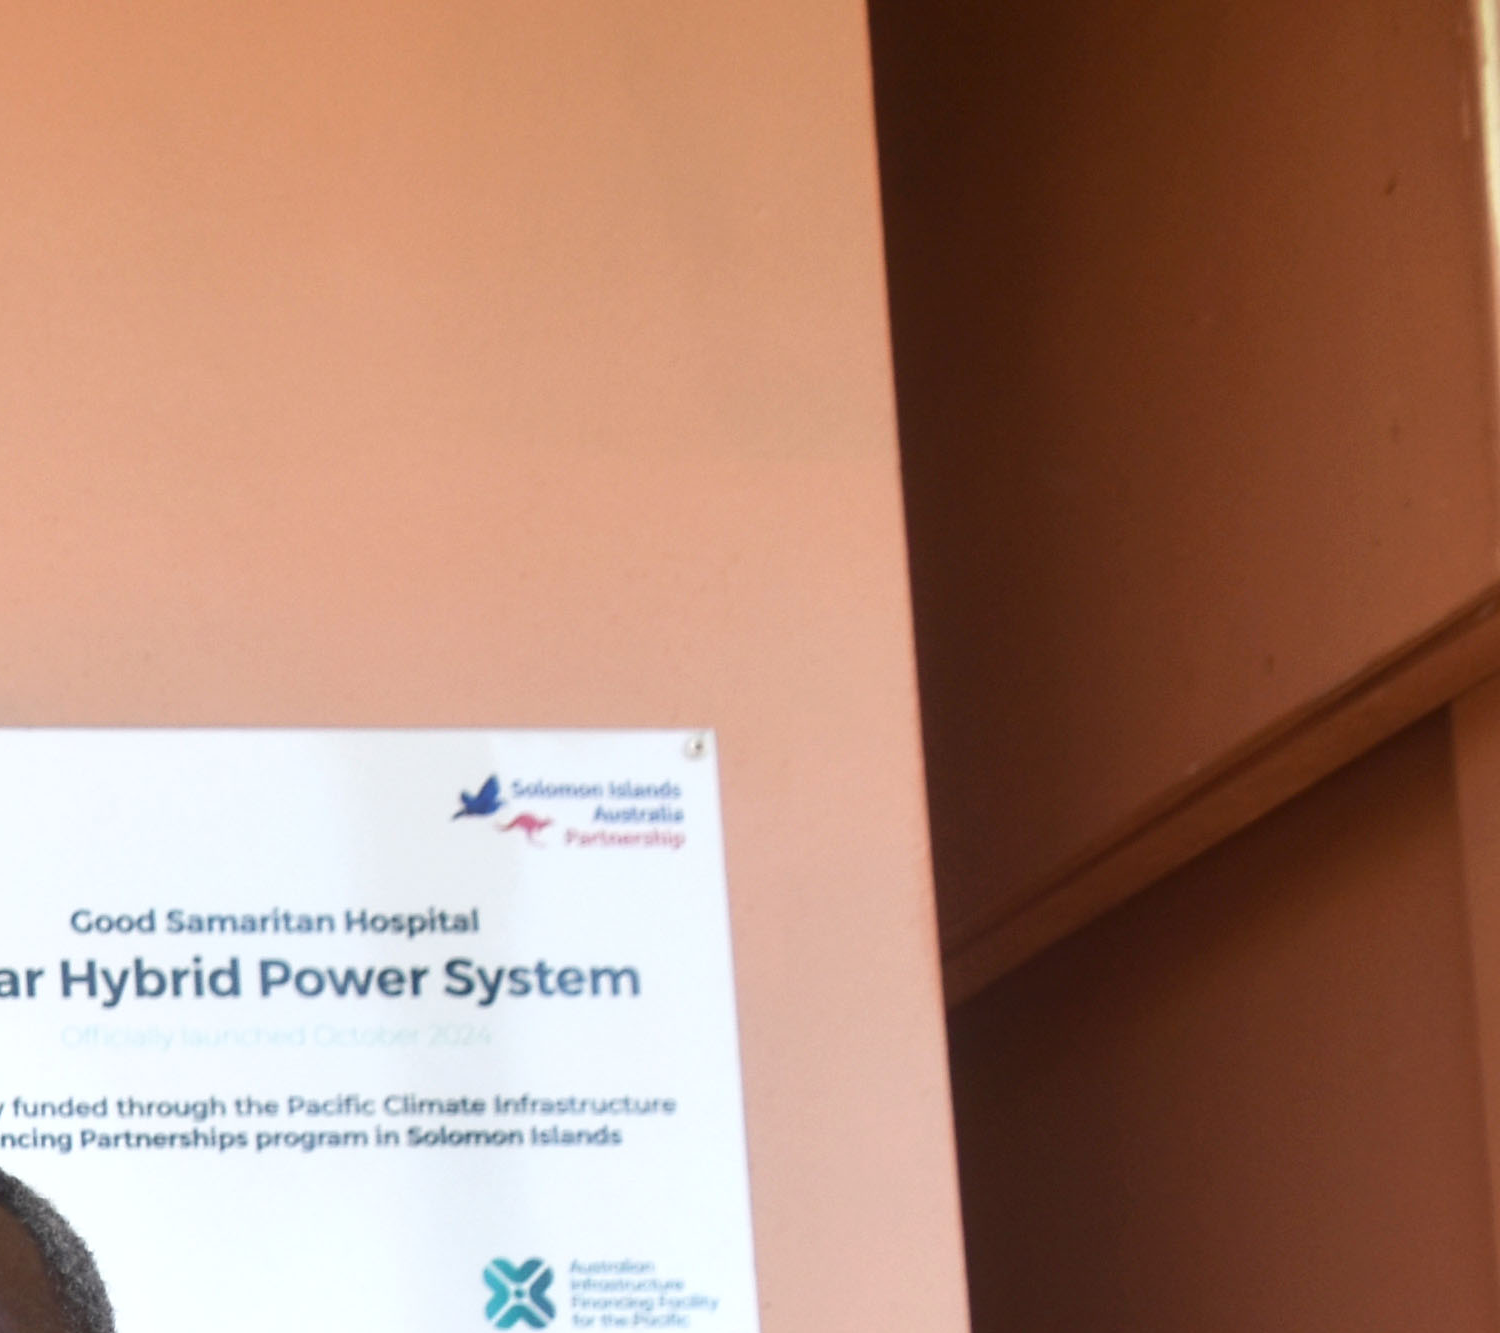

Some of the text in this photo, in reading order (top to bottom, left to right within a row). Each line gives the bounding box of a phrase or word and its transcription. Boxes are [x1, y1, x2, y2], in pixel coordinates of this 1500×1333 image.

[511, 779, 682, 799] Solomon Islands
[593, 804, 684, 823] Australia
[565, 828, 687, 850] Partnership
[70, 906, 480, 938] Good Samaritan Hospital
[60, 955, 242, 1008] Hybrid
[259, 957, 430, 998] Power
[444, 957, 642, 1007] System
[313, 1022, 420, 1046] October
[12, 1097, 108, 1119] funded
[117, 1096, 226, 1122] through
[235, 1096, 280, 1117] the
[287, 1095, 376, 1117] Pacific
[383, 1095, 487, 1117] Climate
[494, 1093, 678, 1116] Infrastructure
[80, 1127, 248, 1151] Partnerships
[256, 1129, 369, 1151] program
[376, 1125, 400, 1147] in
[407, 1125, 525, 1147] Solomon
[531, 1125, 624, 1147] Islands
